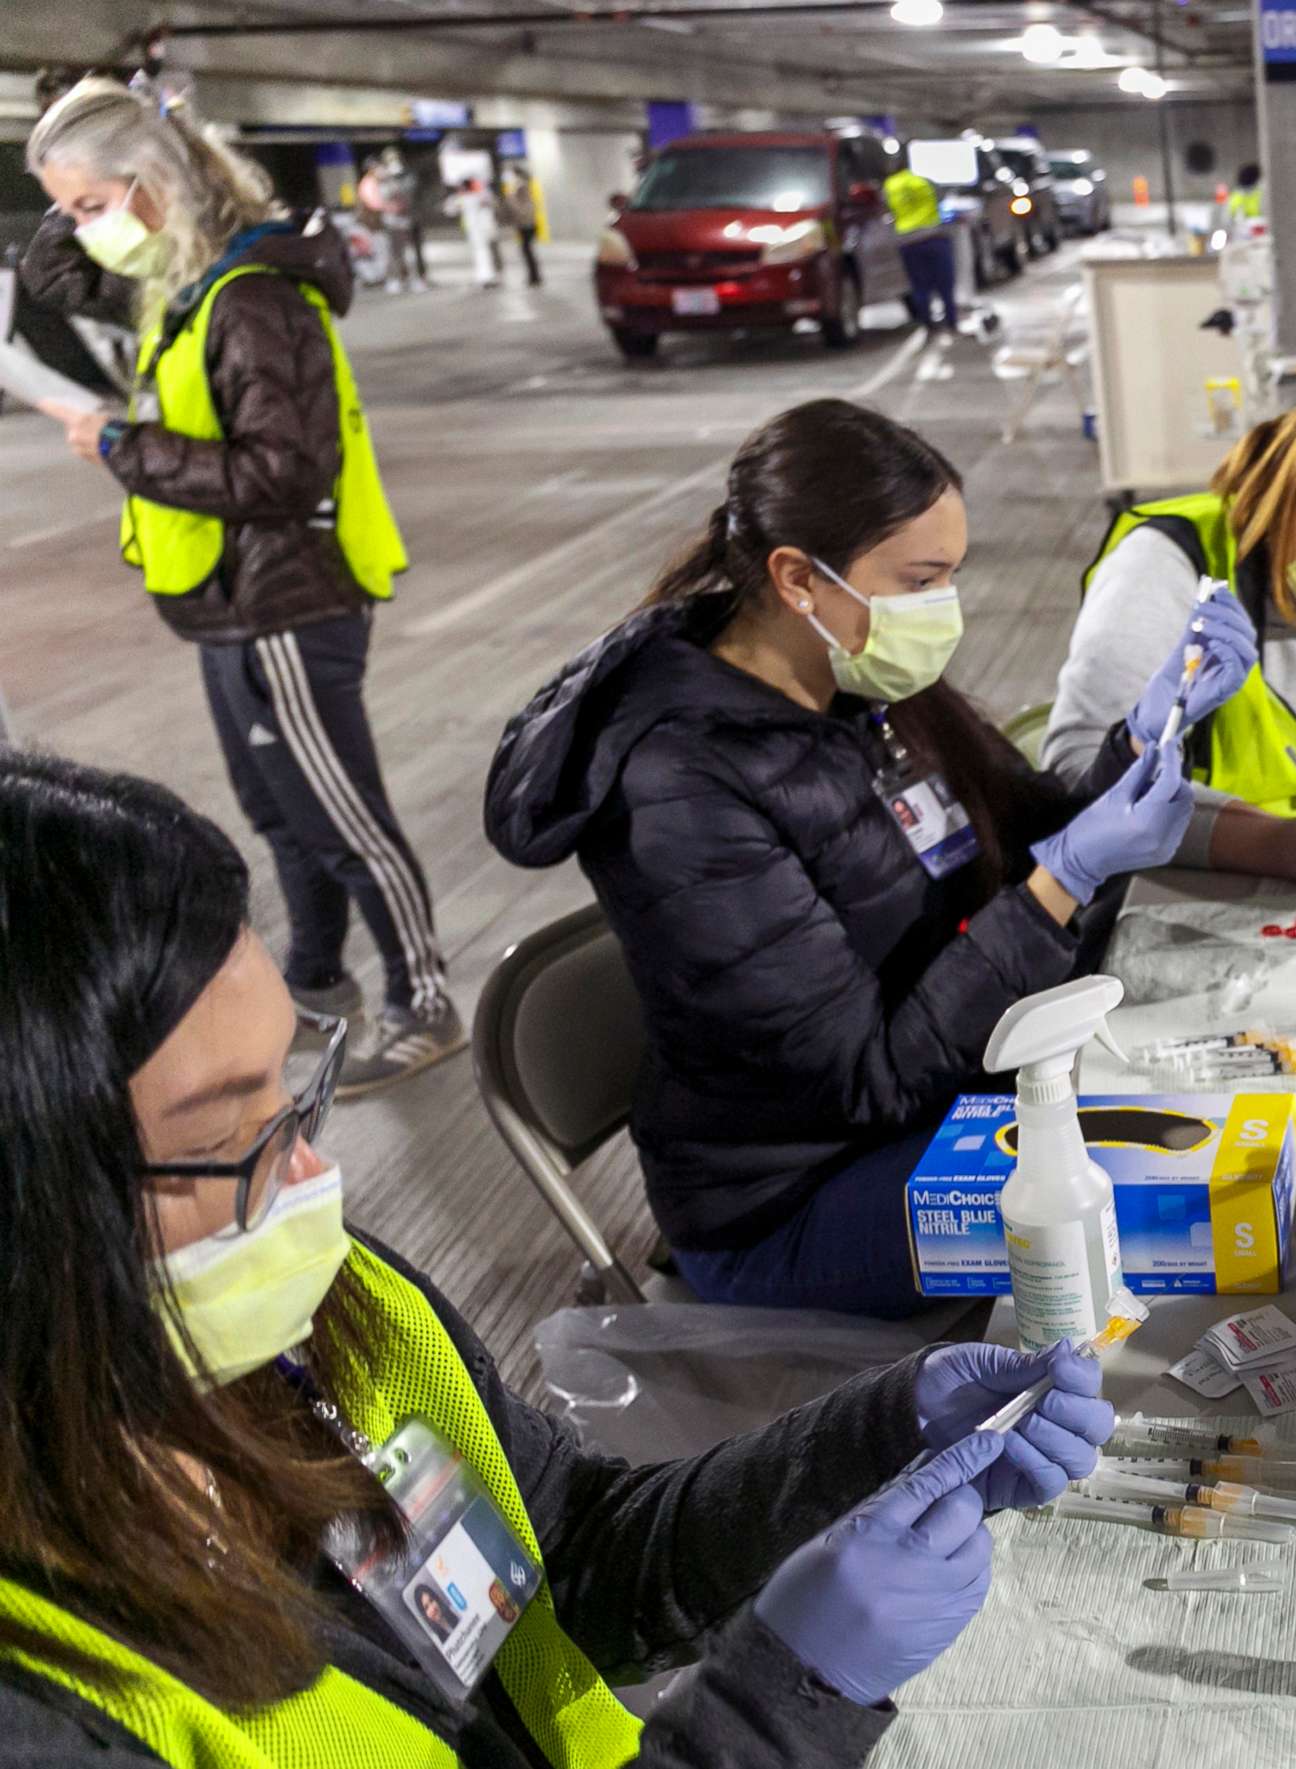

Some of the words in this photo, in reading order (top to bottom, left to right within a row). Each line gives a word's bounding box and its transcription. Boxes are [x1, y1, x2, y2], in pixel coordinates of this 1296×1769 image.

[1239, 1118, 1269, 1141] S
[917, 1209, 958, 1222] STEEL
[960, 1210, 996, 1223] BLUE
[919, 1221, 971, 1235] NITRILE
[1234, 1222, 1255, 1249] S
